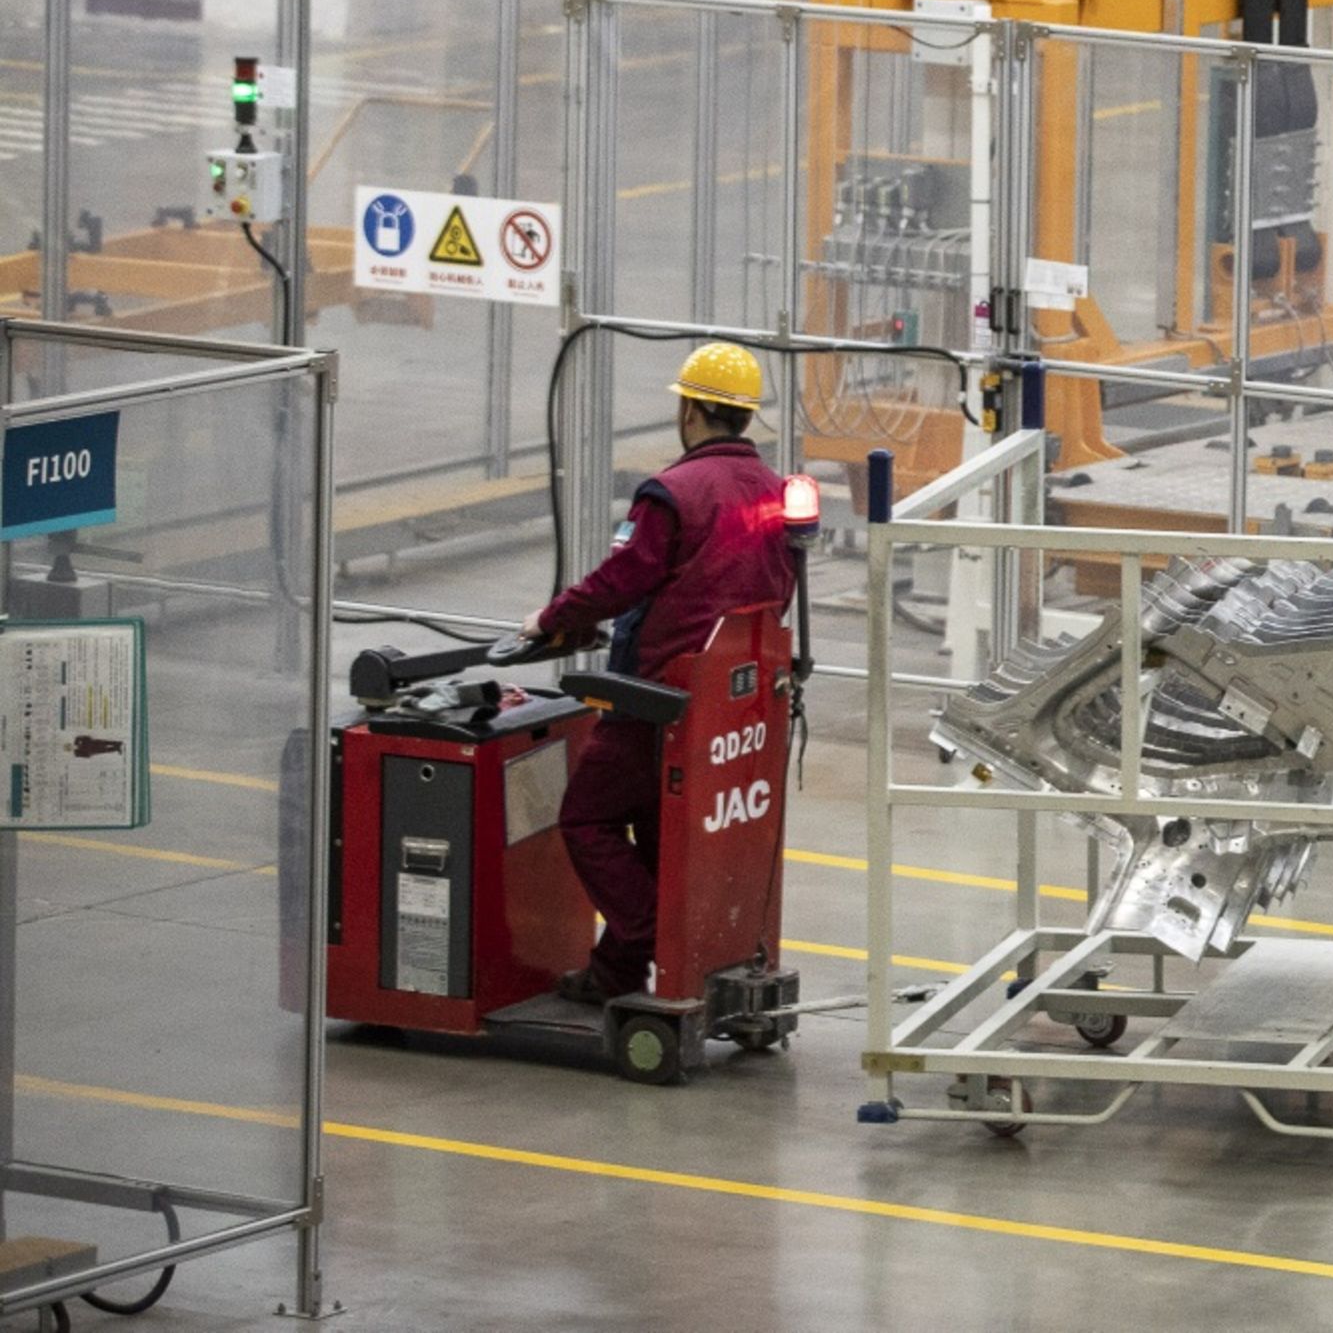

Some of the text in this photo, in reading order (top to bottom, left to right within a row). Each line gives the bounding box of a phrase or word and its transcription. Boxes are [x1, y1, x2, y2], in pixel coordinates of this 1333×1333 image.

[26, 448, 92, 487] FI100
[709, 721, 767, 765] QD20
[703, 779, 771, 834] JAC
